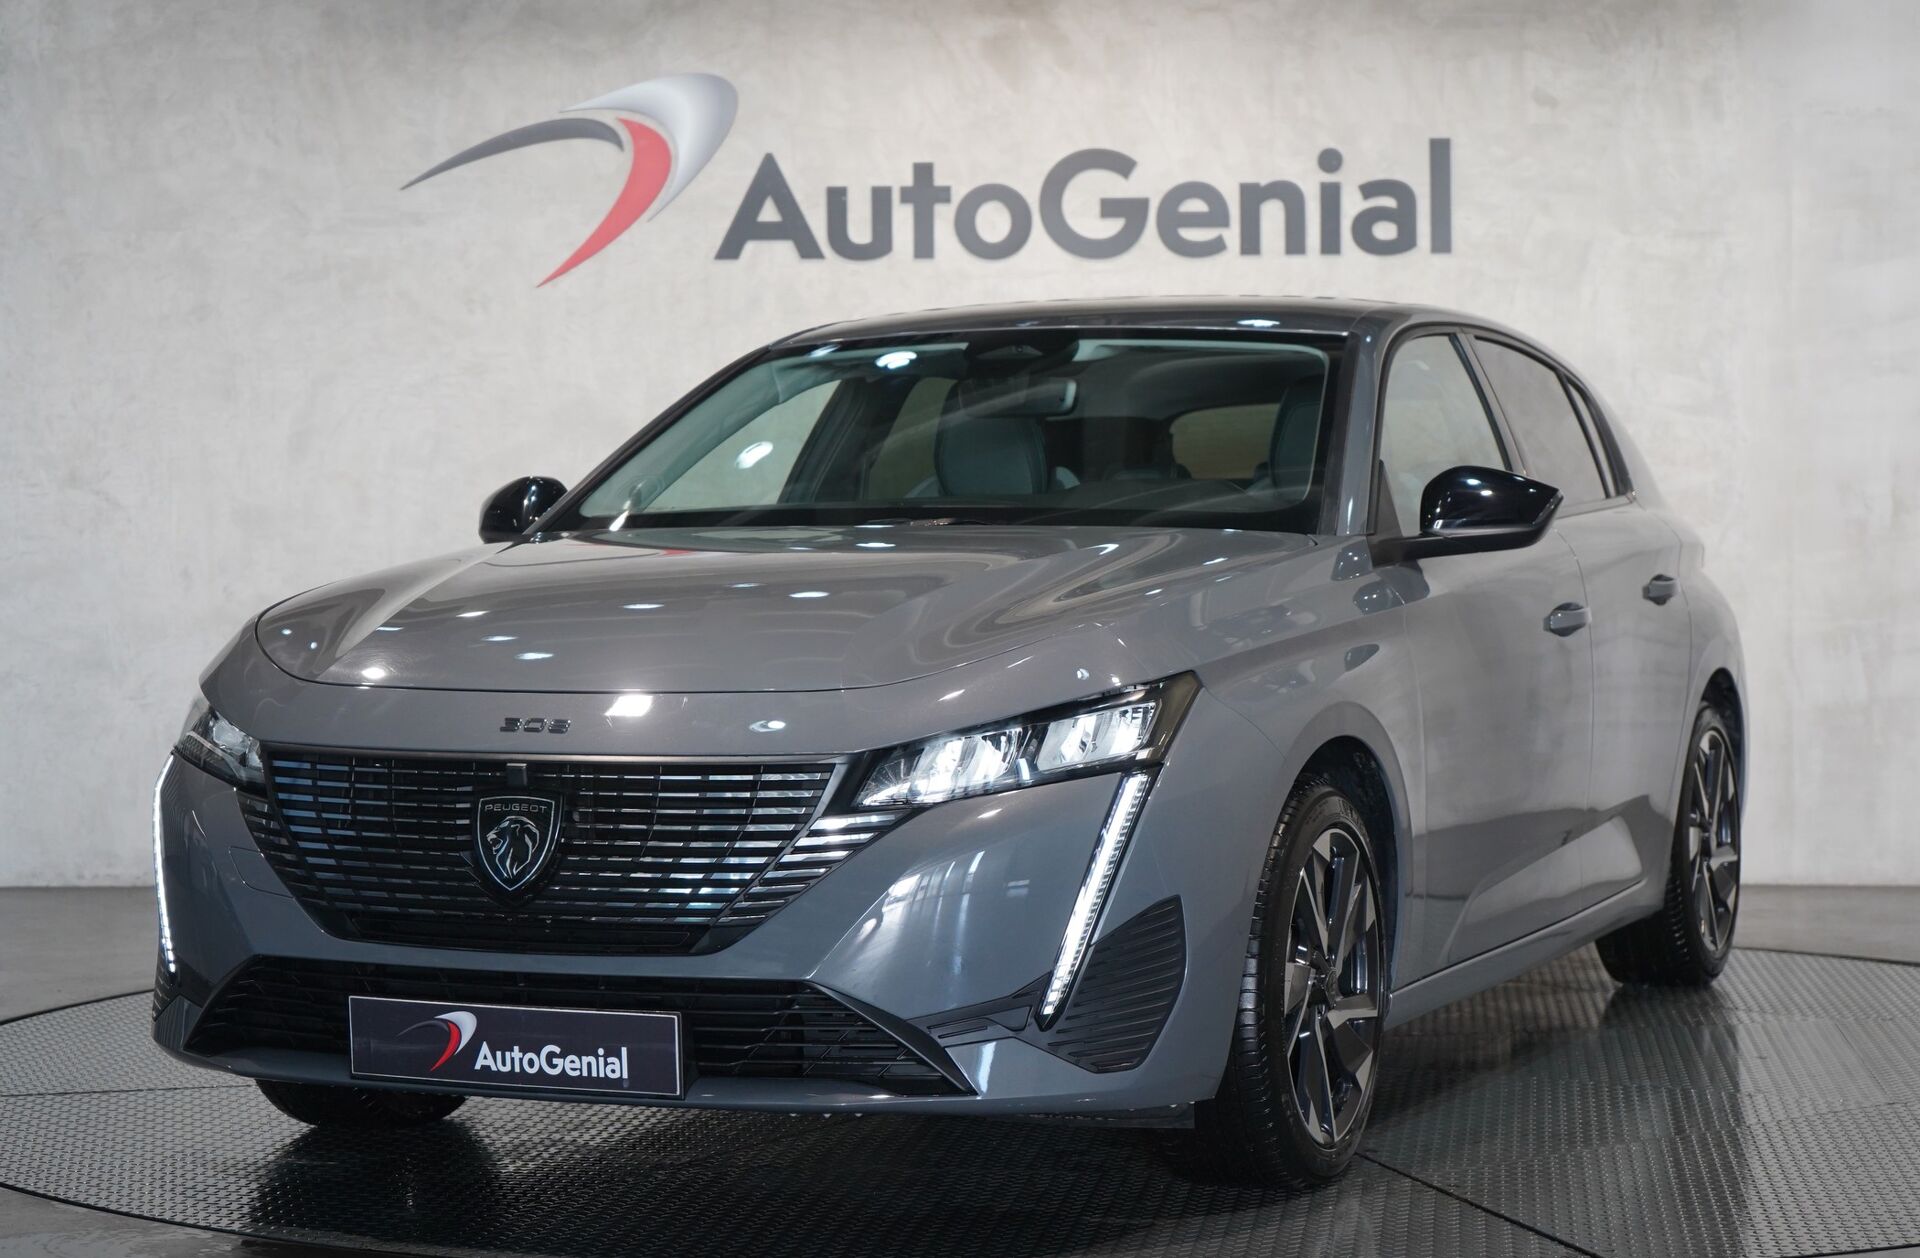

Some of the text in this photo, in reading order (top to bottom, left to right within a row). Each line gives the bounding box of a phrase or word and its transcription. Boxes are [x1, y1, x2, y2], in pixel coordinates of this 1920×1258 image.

[714, 138, 1452, 261] AutoGenial
[500, 717, 571, 734] 308
[484, 803, 547, 813] PEUGEOT
[474, 1041, 628, 1079] AutoGenial
